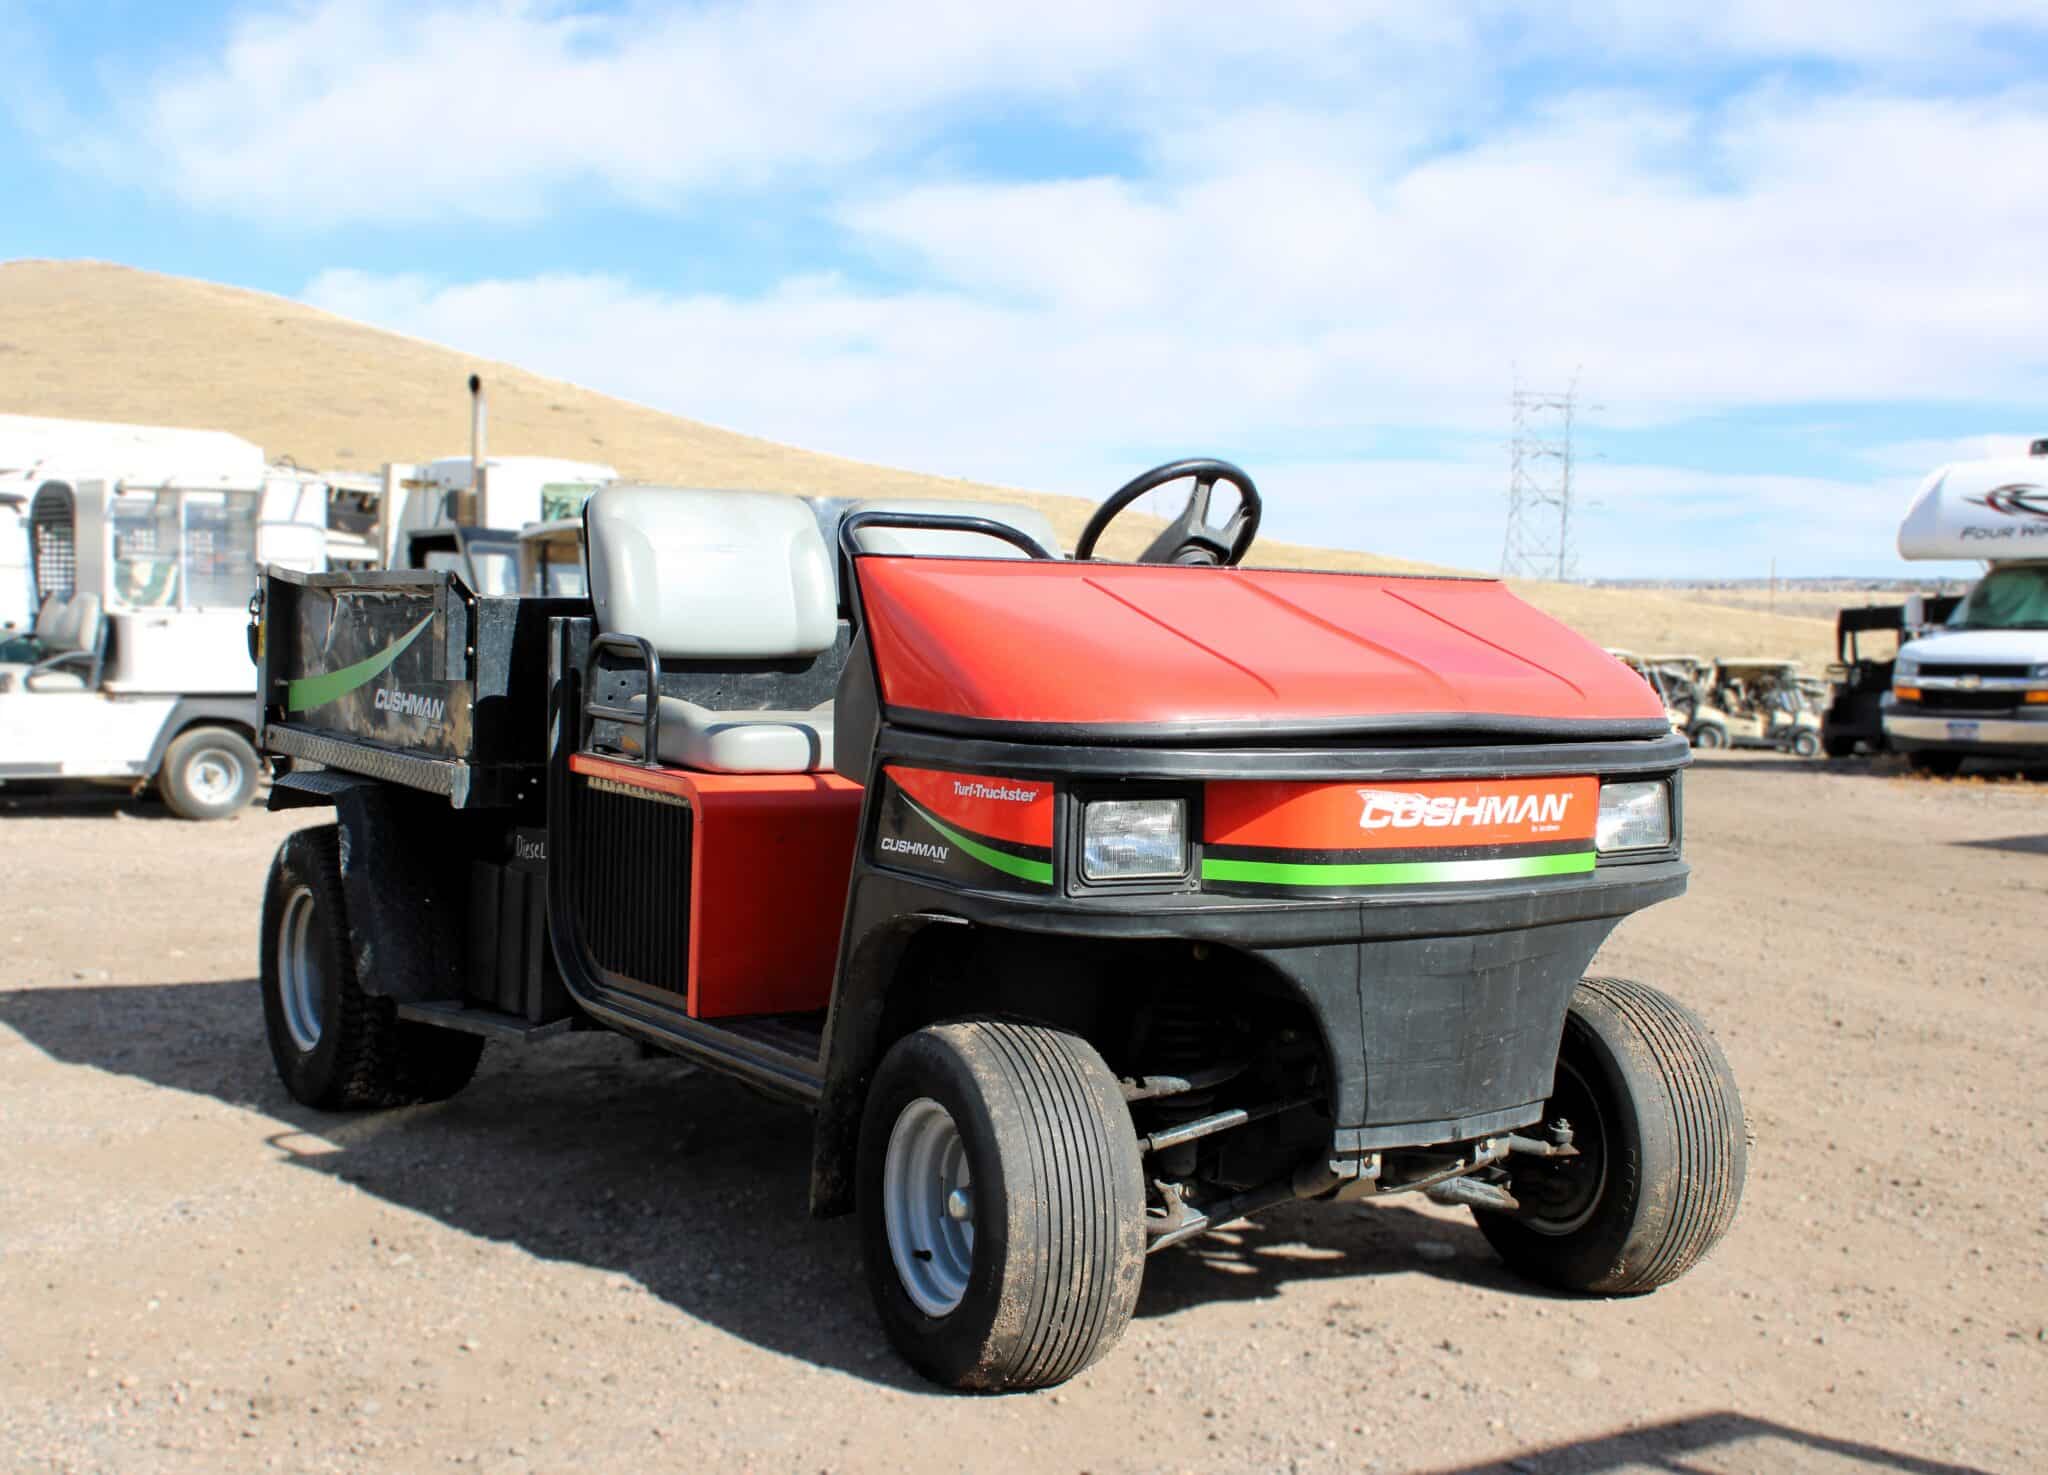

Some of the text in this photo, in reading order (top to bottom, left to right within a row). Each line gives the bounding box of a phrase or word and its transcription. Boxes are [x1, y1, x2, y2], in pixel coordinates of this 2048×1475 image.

[375, 688, 445, 721] CUSHMAN
[953, 781, 1036, 802] Turf-Truckster
[1357, 789, 1570, 828] CUSHMAN
[881, 837, 948, 860] CUSHMAN
